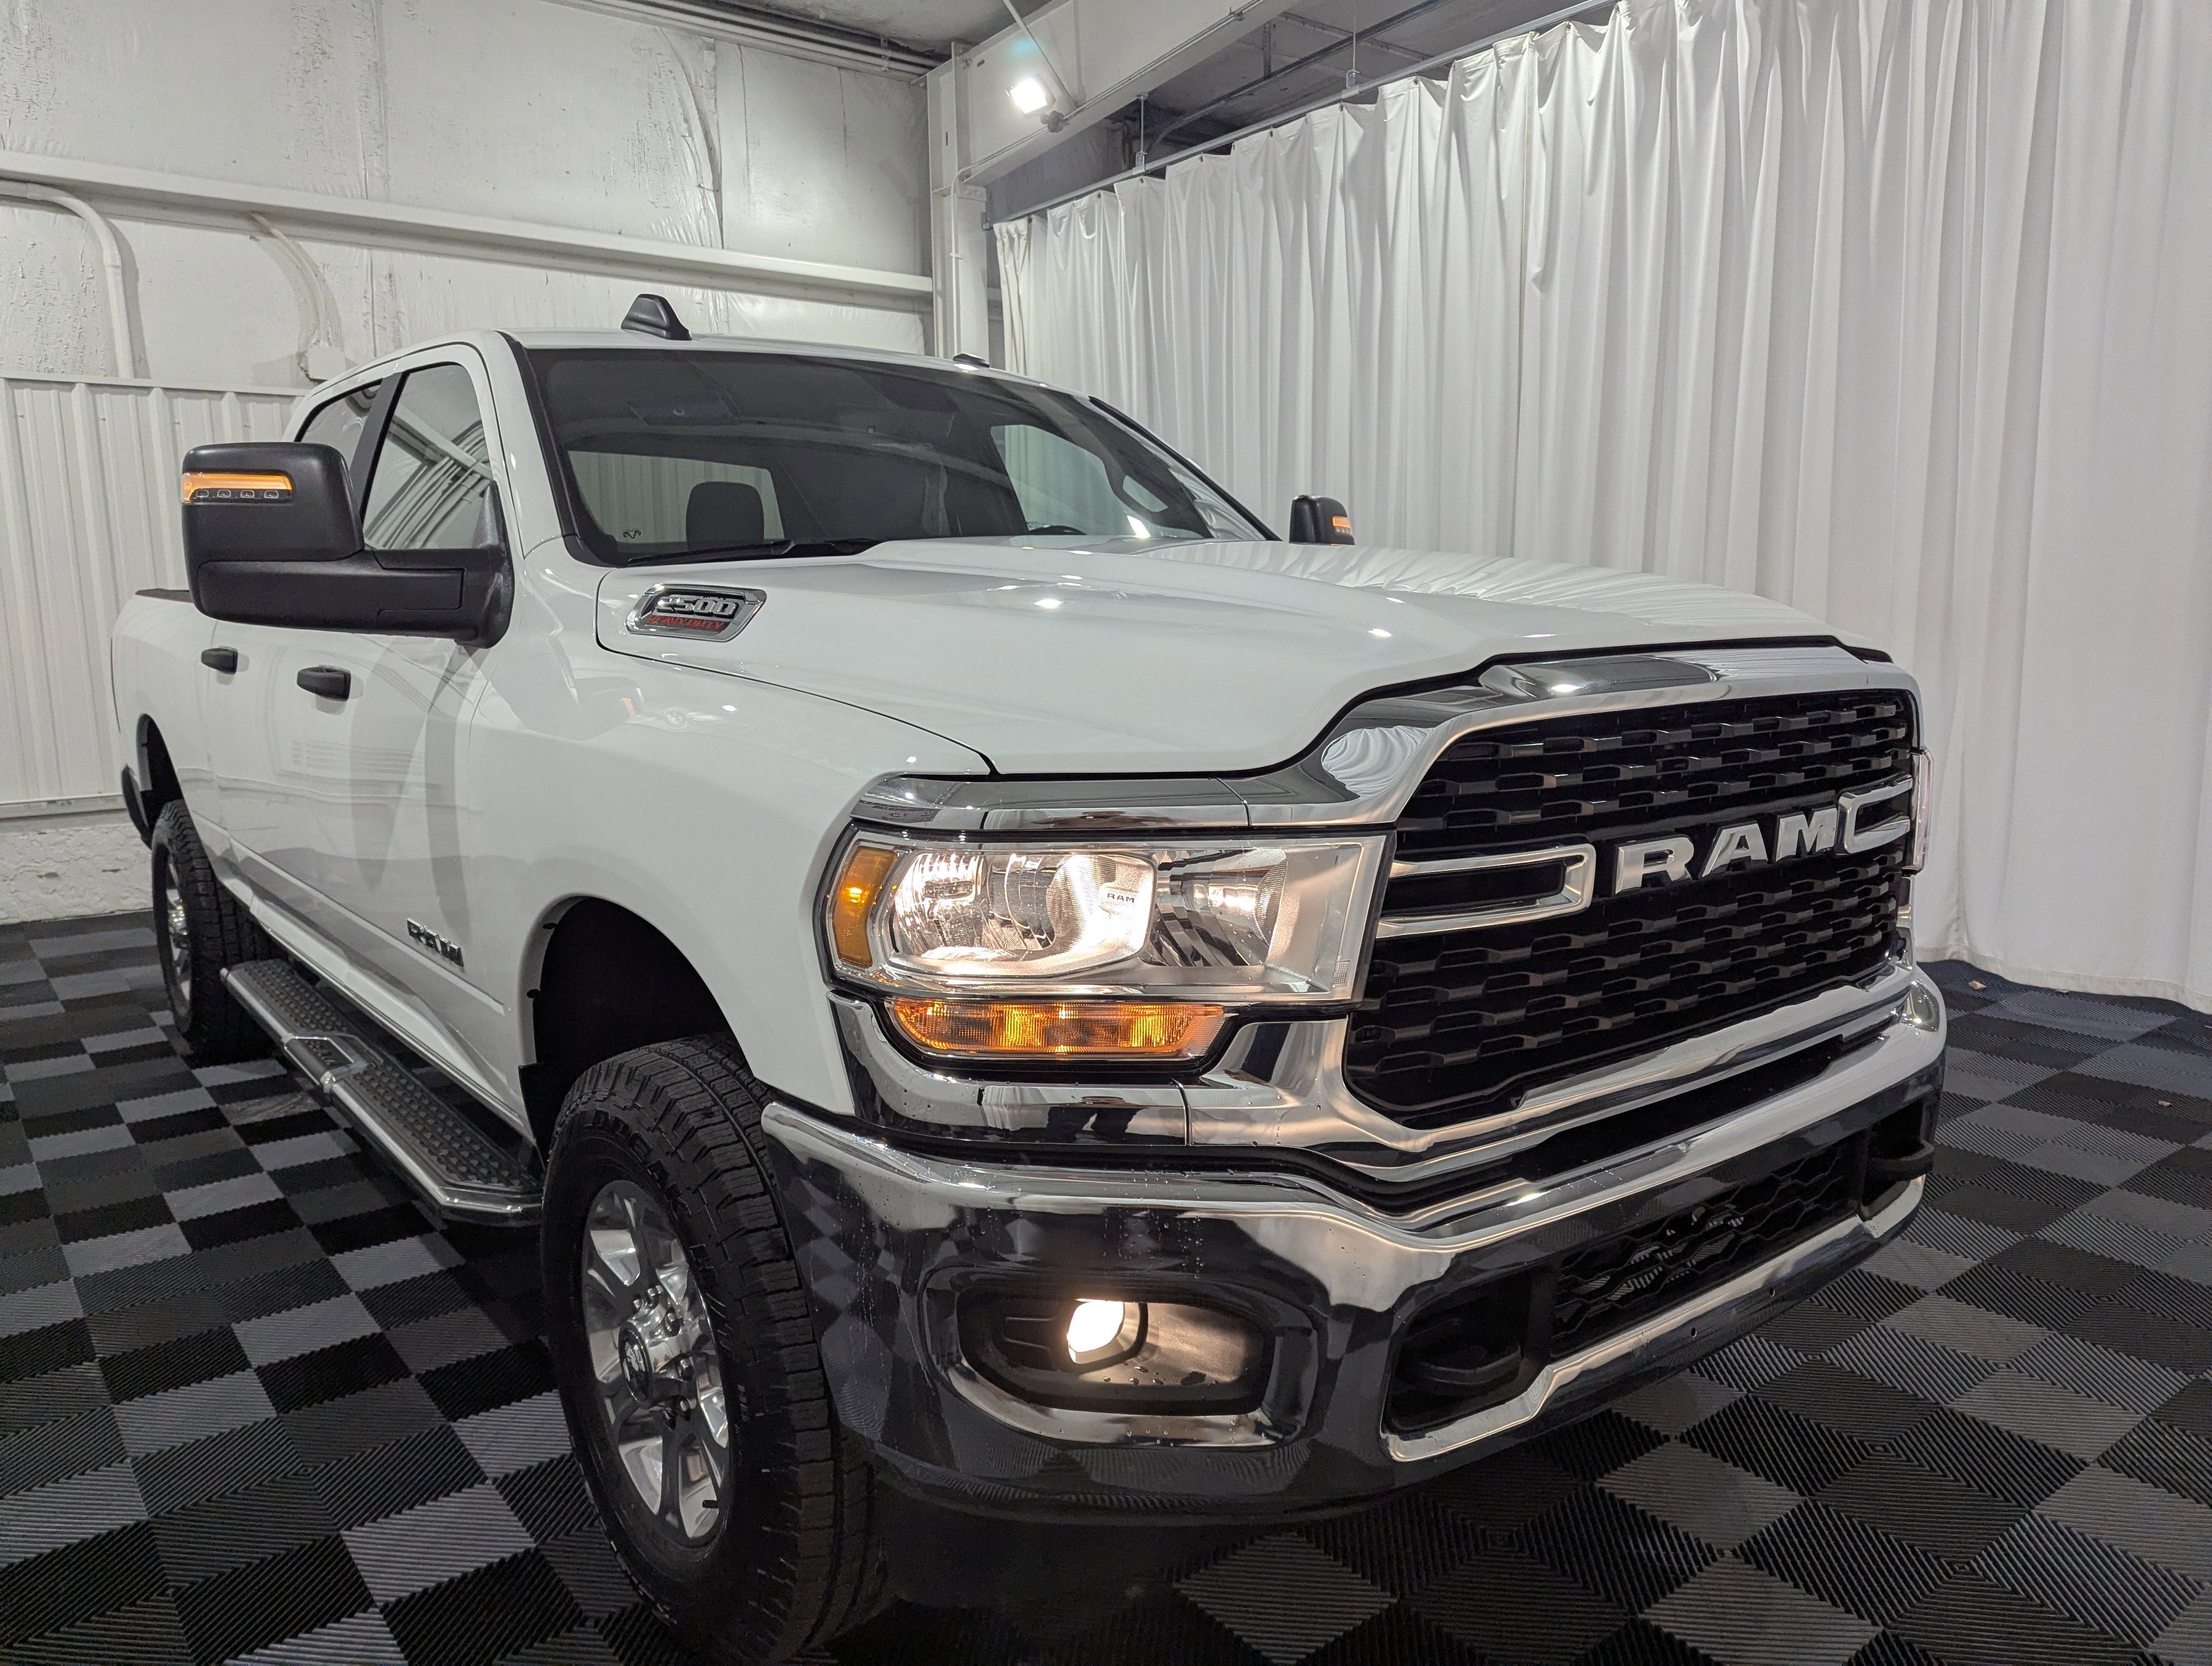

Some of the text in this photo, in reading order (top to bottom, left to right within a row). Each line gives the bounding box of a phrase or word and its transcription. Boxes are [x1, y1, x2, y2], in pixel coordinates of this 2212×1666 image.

[647, 615, 728, 630] HEAVY DUTY
[656, 597, 738, 618] 2500
[1615, 808, 1837, 895] RAM
[1107, 893, 1135, 904] RAM
[407, 917, 464, 967] RAM
[572, 1107, 692, 1221] LDPEAK
